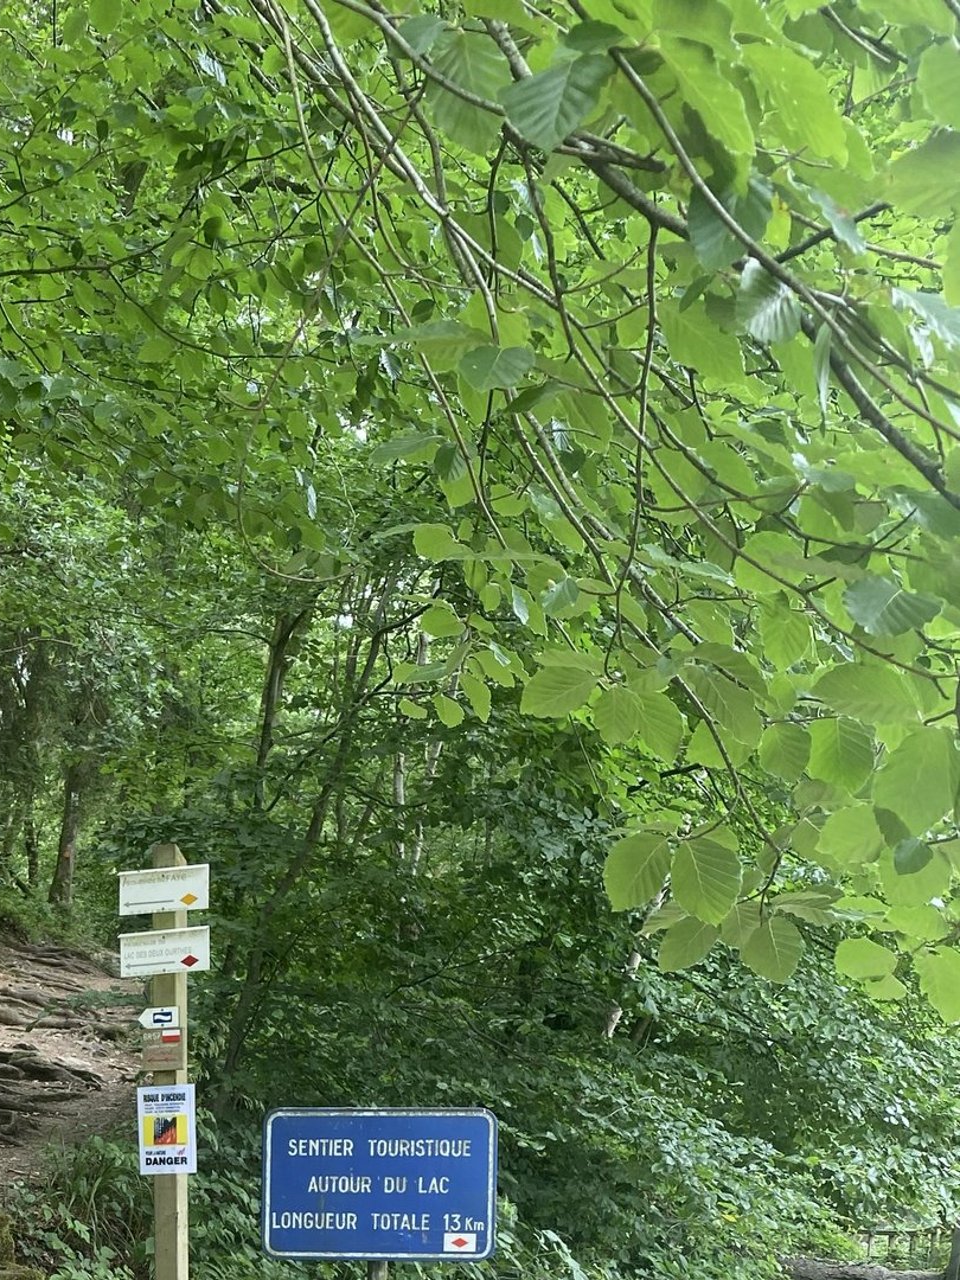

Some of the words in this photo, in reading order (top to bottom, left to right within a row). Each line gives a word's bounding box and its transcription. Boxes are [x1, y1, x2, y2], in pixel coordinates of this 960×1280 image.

[288, 1138, 354, 1157] SENTIER
[368, 1139, 472, 1158] TOURISTIQUE
[145, 1156, 188, 1166] DANGER
[307, 1176, 372, 1193] AUTOUR
[384, 1176, 407, 1193] DU
[418, 1176, 450, 1194] LAC
[271, 1211, 358, 1230] LONGUEUR
[371, 1213, 431, 1231] TOTALE
[443, 1213, 461, 1231] 13
[465, 1217, 485, 1231] Km
